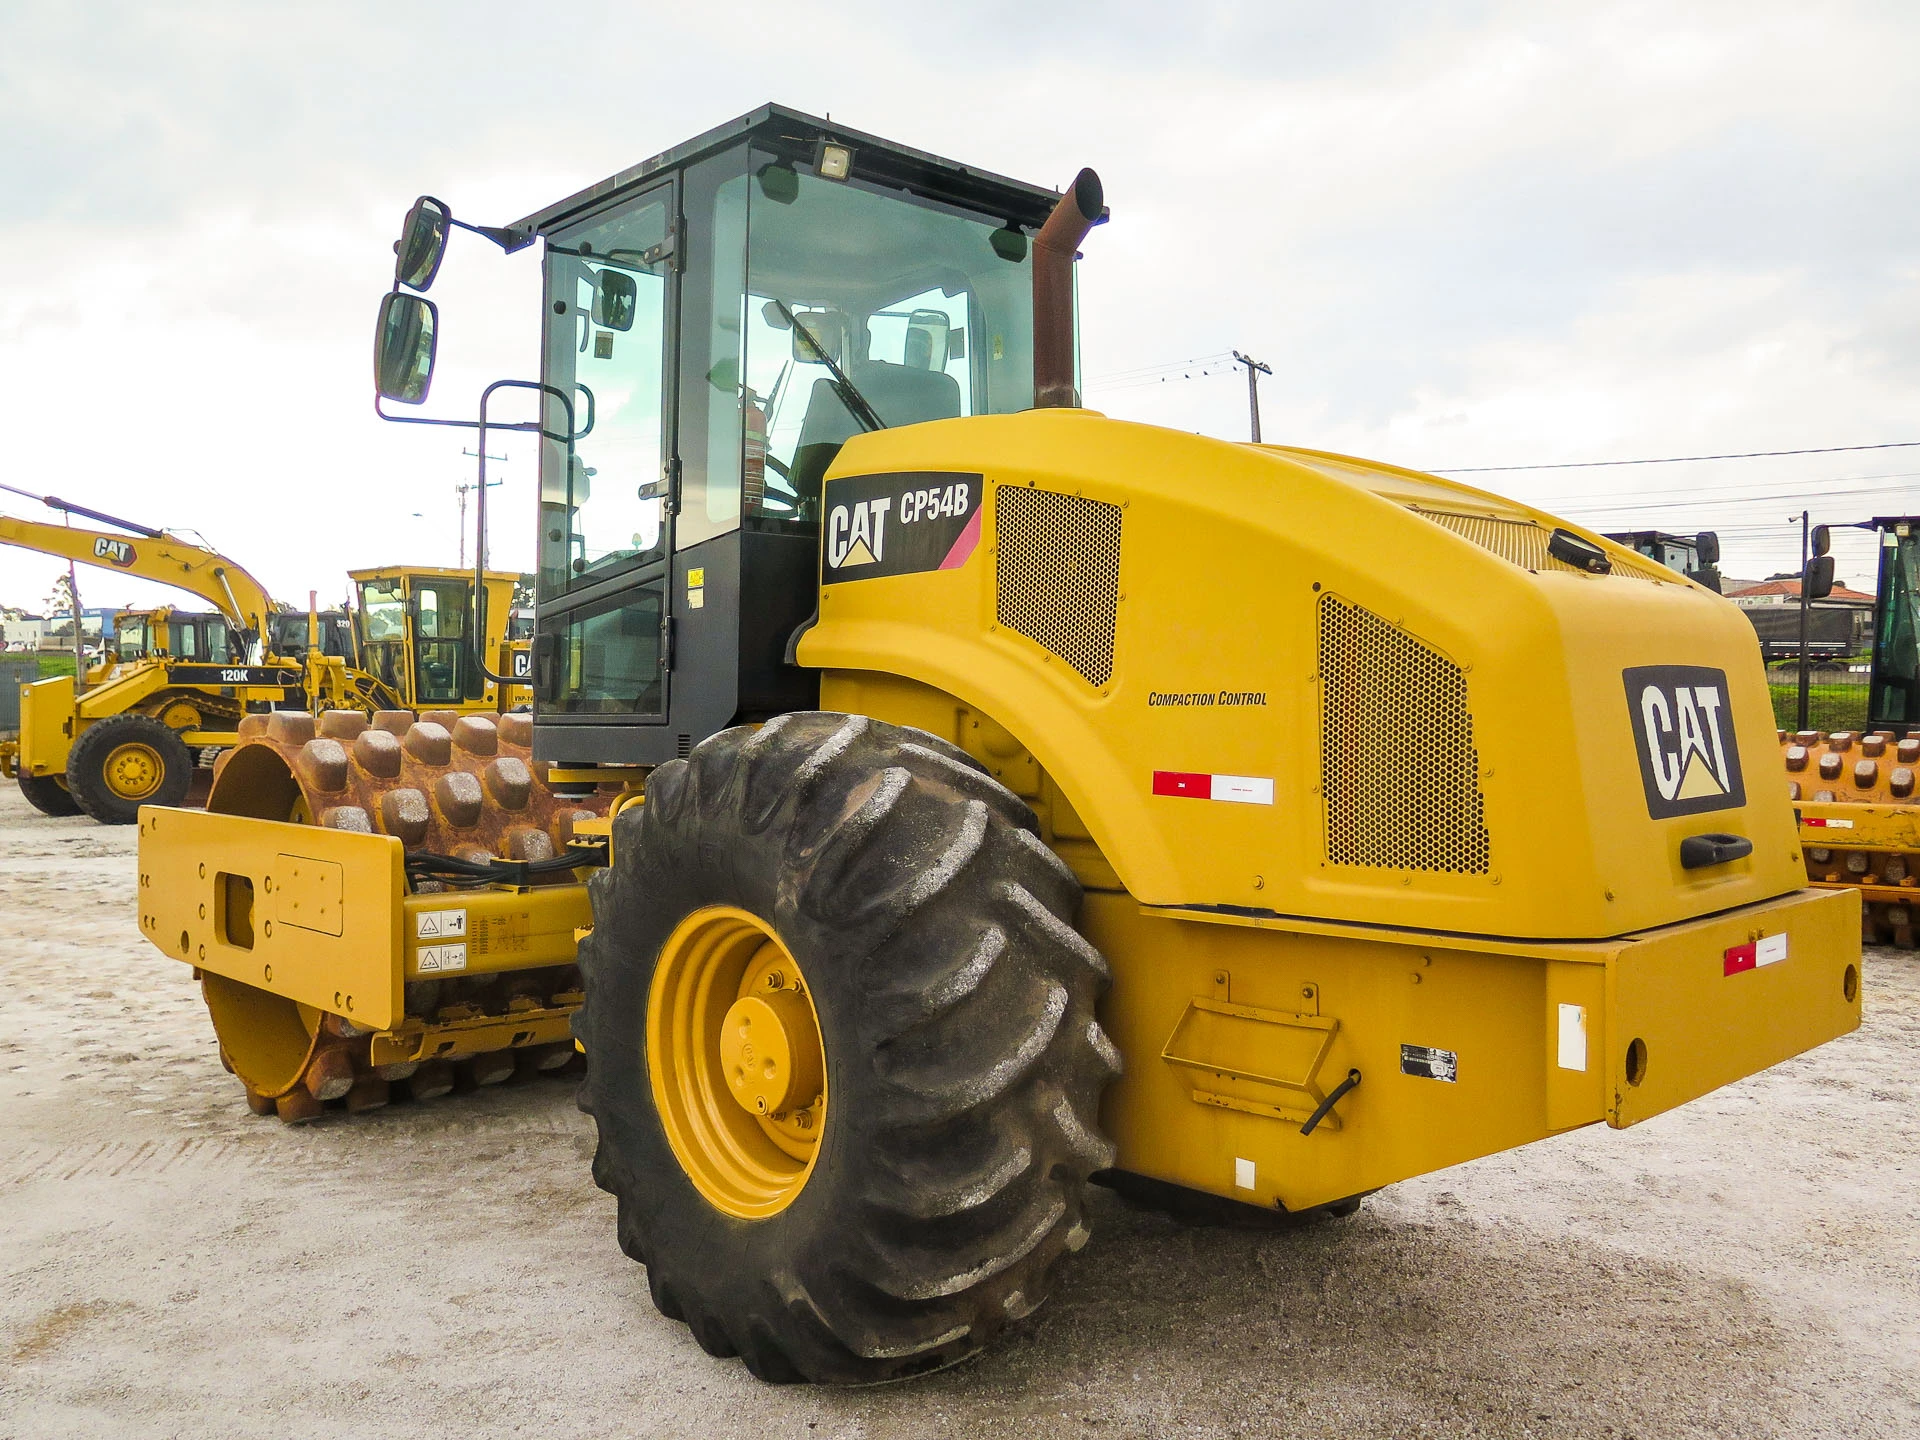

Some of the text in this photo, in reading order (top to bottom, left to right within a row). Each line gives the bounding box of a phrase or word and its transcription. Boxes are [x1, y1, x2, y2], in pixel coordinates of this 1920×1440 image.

[829, 483, 969, 569] CAT CP54B
[95, 537, 130, 563] CAT
[336, 619, 351, 628] 320
[220, 669, 249, 682] 120K
[1641, 685, 1731, 801] CAT
